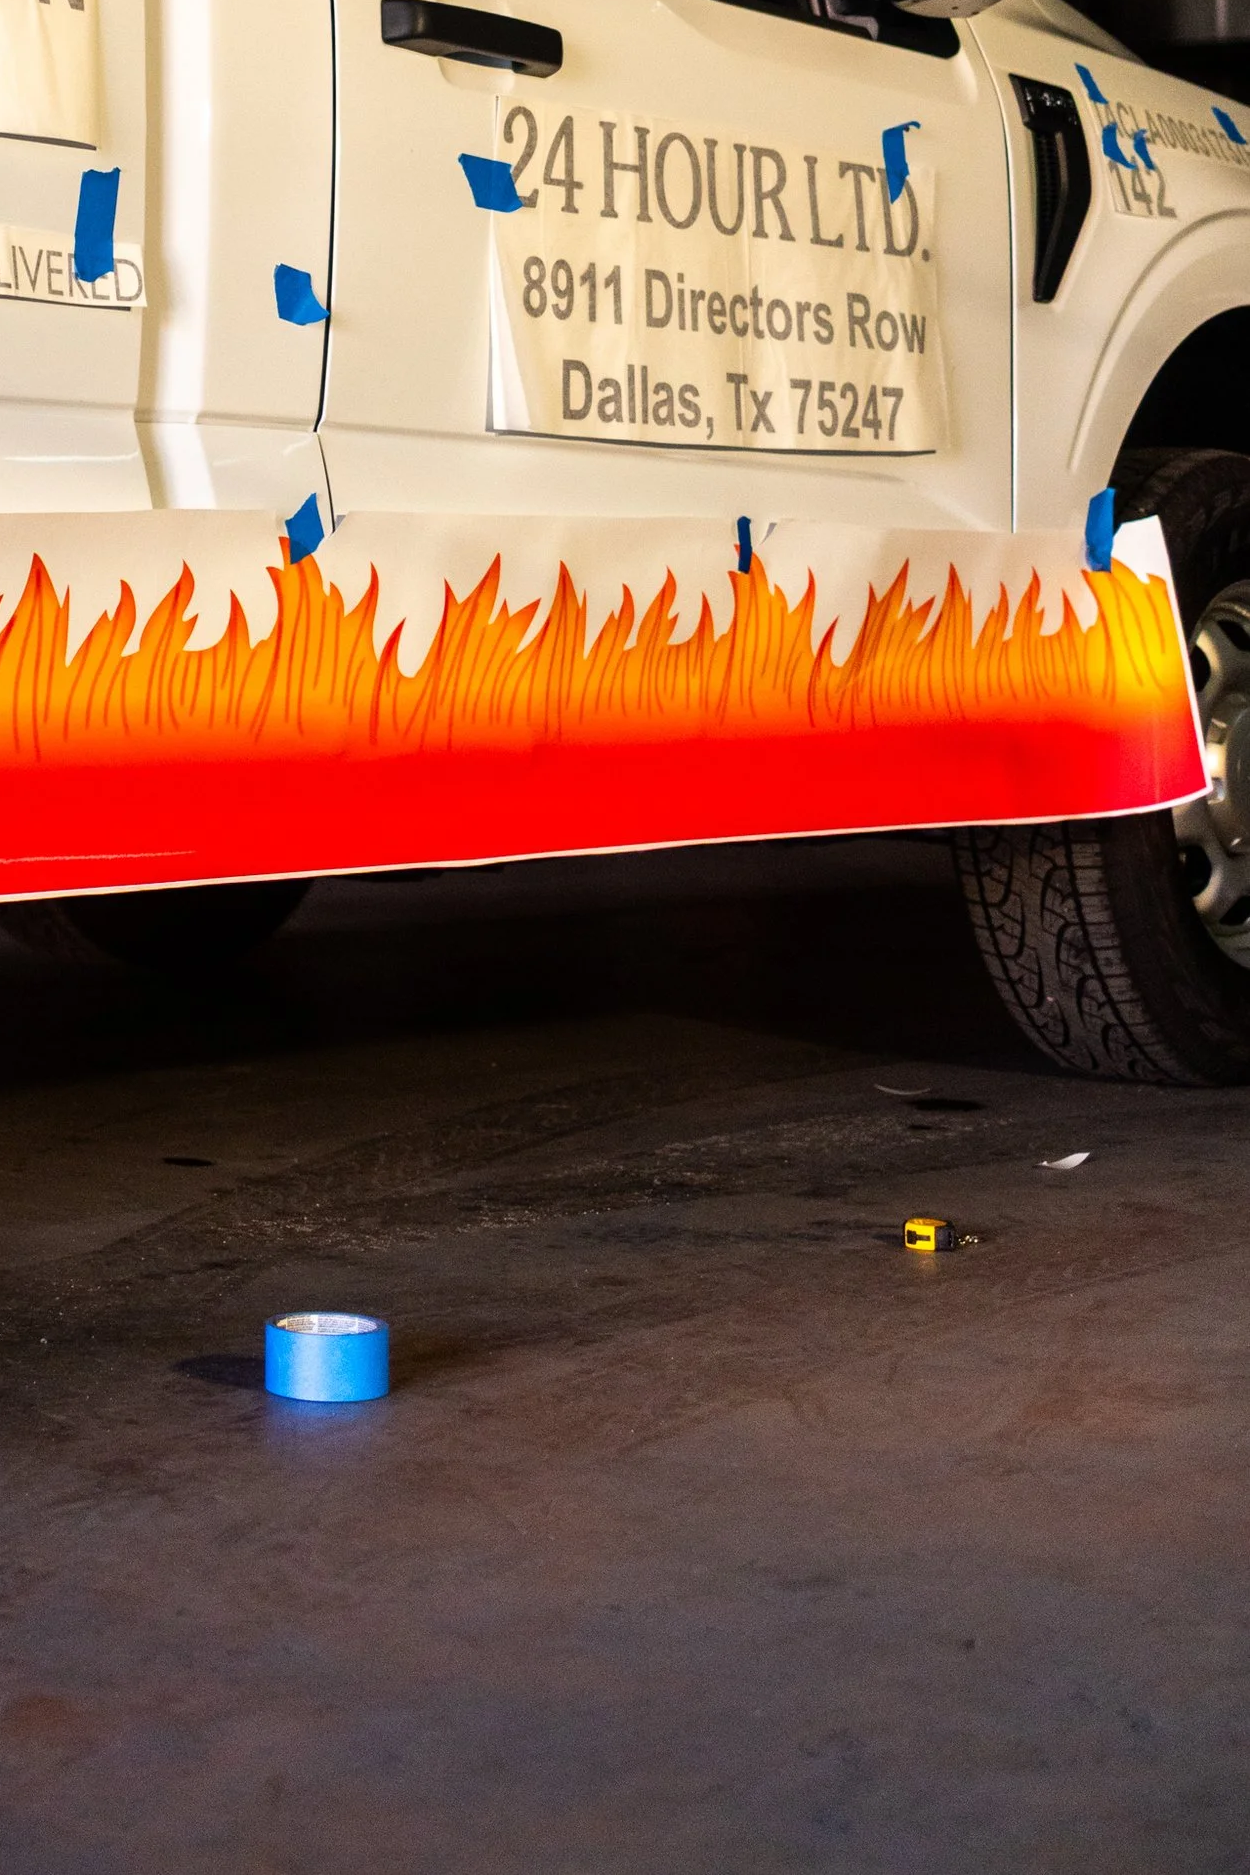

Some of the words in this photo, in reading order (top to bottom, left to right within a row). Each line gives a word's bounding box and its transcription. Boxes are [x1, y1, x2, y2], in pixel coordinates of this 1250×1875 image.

[503, 105, 584, 214] 24
[599, 121, 796, 242] HOUR
[804, 155, 930, 262] LTD.
[1108, 156, 1177, 218] 142
[523, 256, 623, 324] 8911
[645, 269, 834, 345] Directors
[847, 293, 927, 356] Row
[562, 359, 714, 440] Dallas,
[726, 372, 775, 433] Tx
[790, 379, 903, 441] 75247
